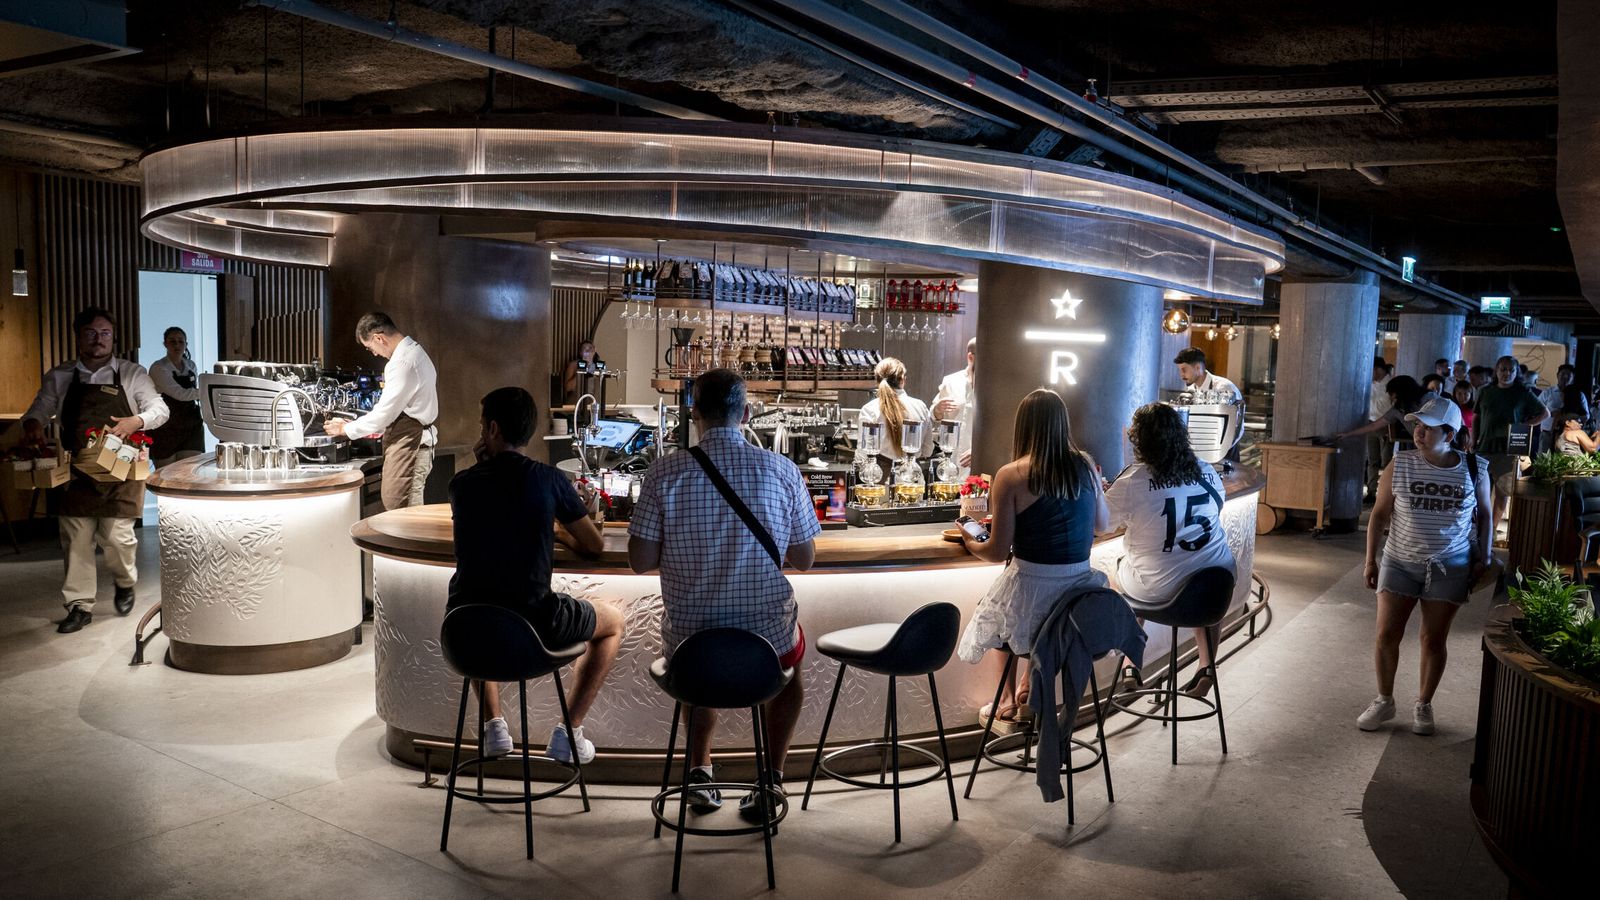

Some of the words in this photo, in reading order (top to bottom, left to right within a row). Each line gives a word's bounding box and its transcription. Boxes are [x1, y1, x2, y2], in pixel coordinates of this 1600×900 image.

[191, 258, 214, 268] SALIDA
[1049, 350, 1079, 385] R
[1184, 472, 1216, 487] GER
[1409, 481, 1465, 499] GOOD
[1161, 493, 1212, 553] 15
